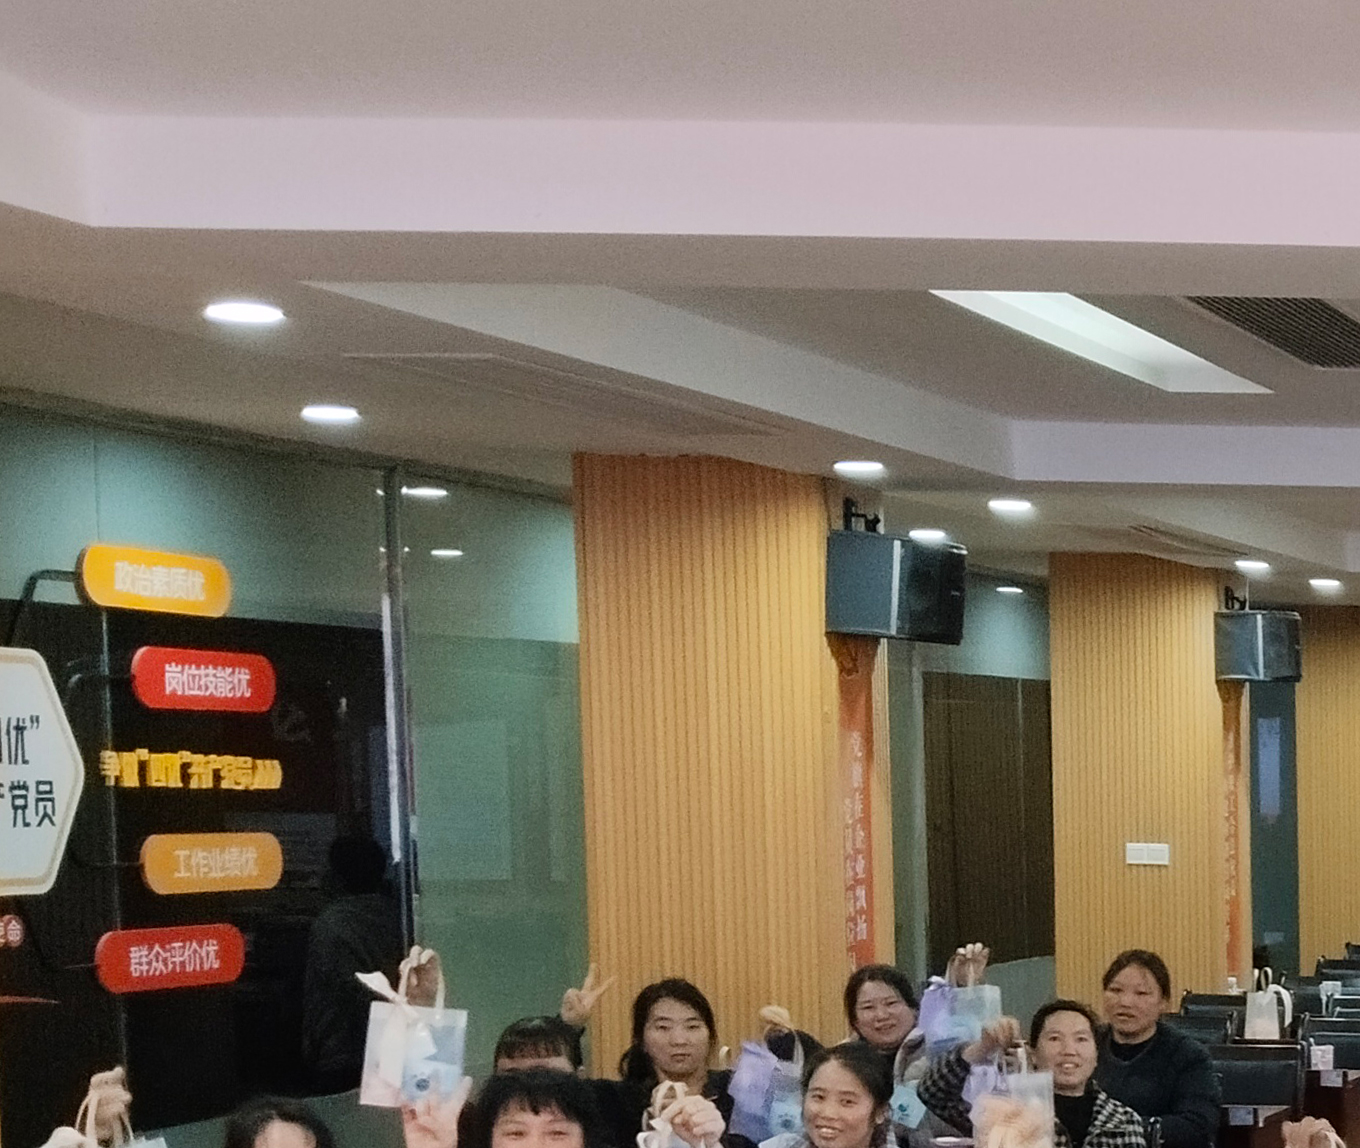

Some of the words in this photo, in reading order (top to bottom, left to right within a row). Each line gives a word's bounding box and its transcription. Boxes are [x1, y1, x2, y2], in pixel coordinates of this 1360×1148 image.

[164, 662, 252, 698] 岗位技能优
[0, 714, 40, 765] 优”
[0, 780, 56, 828] 党员
[173, 846, 259, 878] 工作业绩优
[128, 940, 220, 977] 群众评价优
